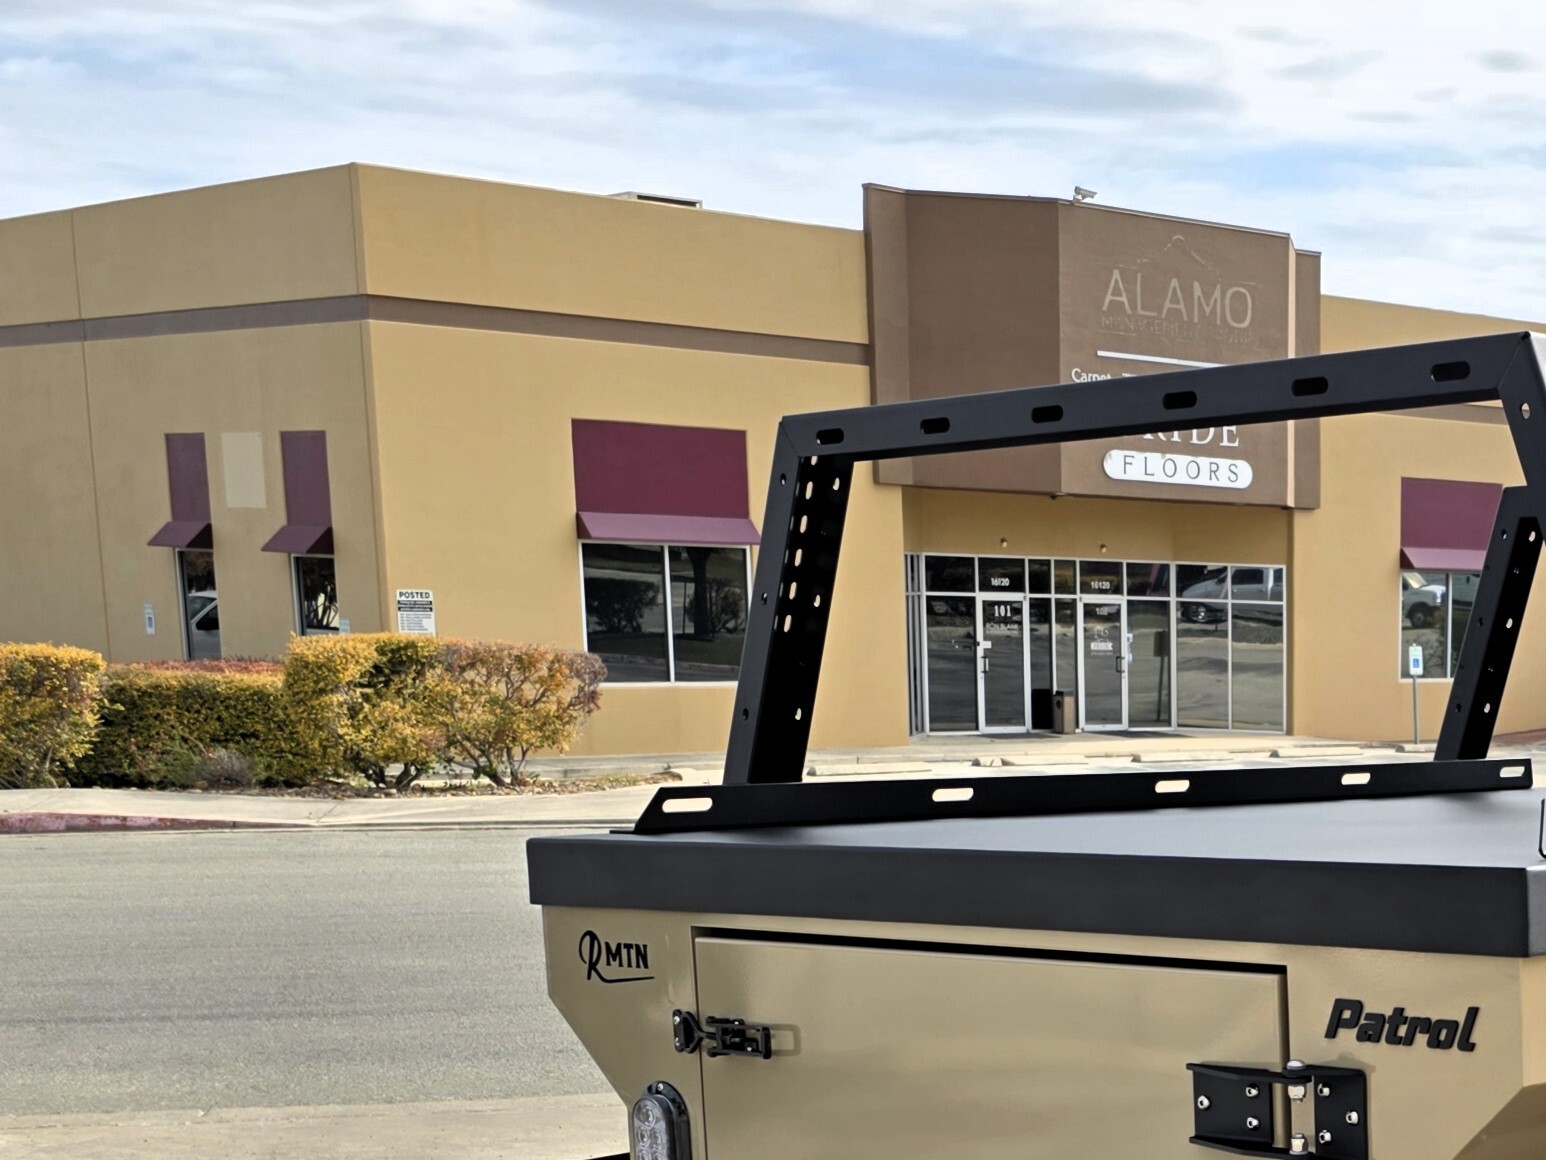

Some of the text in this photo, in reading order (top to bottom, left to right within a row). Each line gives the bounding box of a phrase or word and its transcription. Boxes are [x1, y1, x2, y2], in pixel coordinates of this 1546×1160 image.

[1101, 269, 1252, 329] ALAMO
[1123, 455, 1239, 482] FLOORS
[991, 577, 1010, 587] 16120
[398, 591, 431, 599] POSTED
[995, 605, 1011, 617] 101
[1324, 998, 1480, 1052] Patrol
